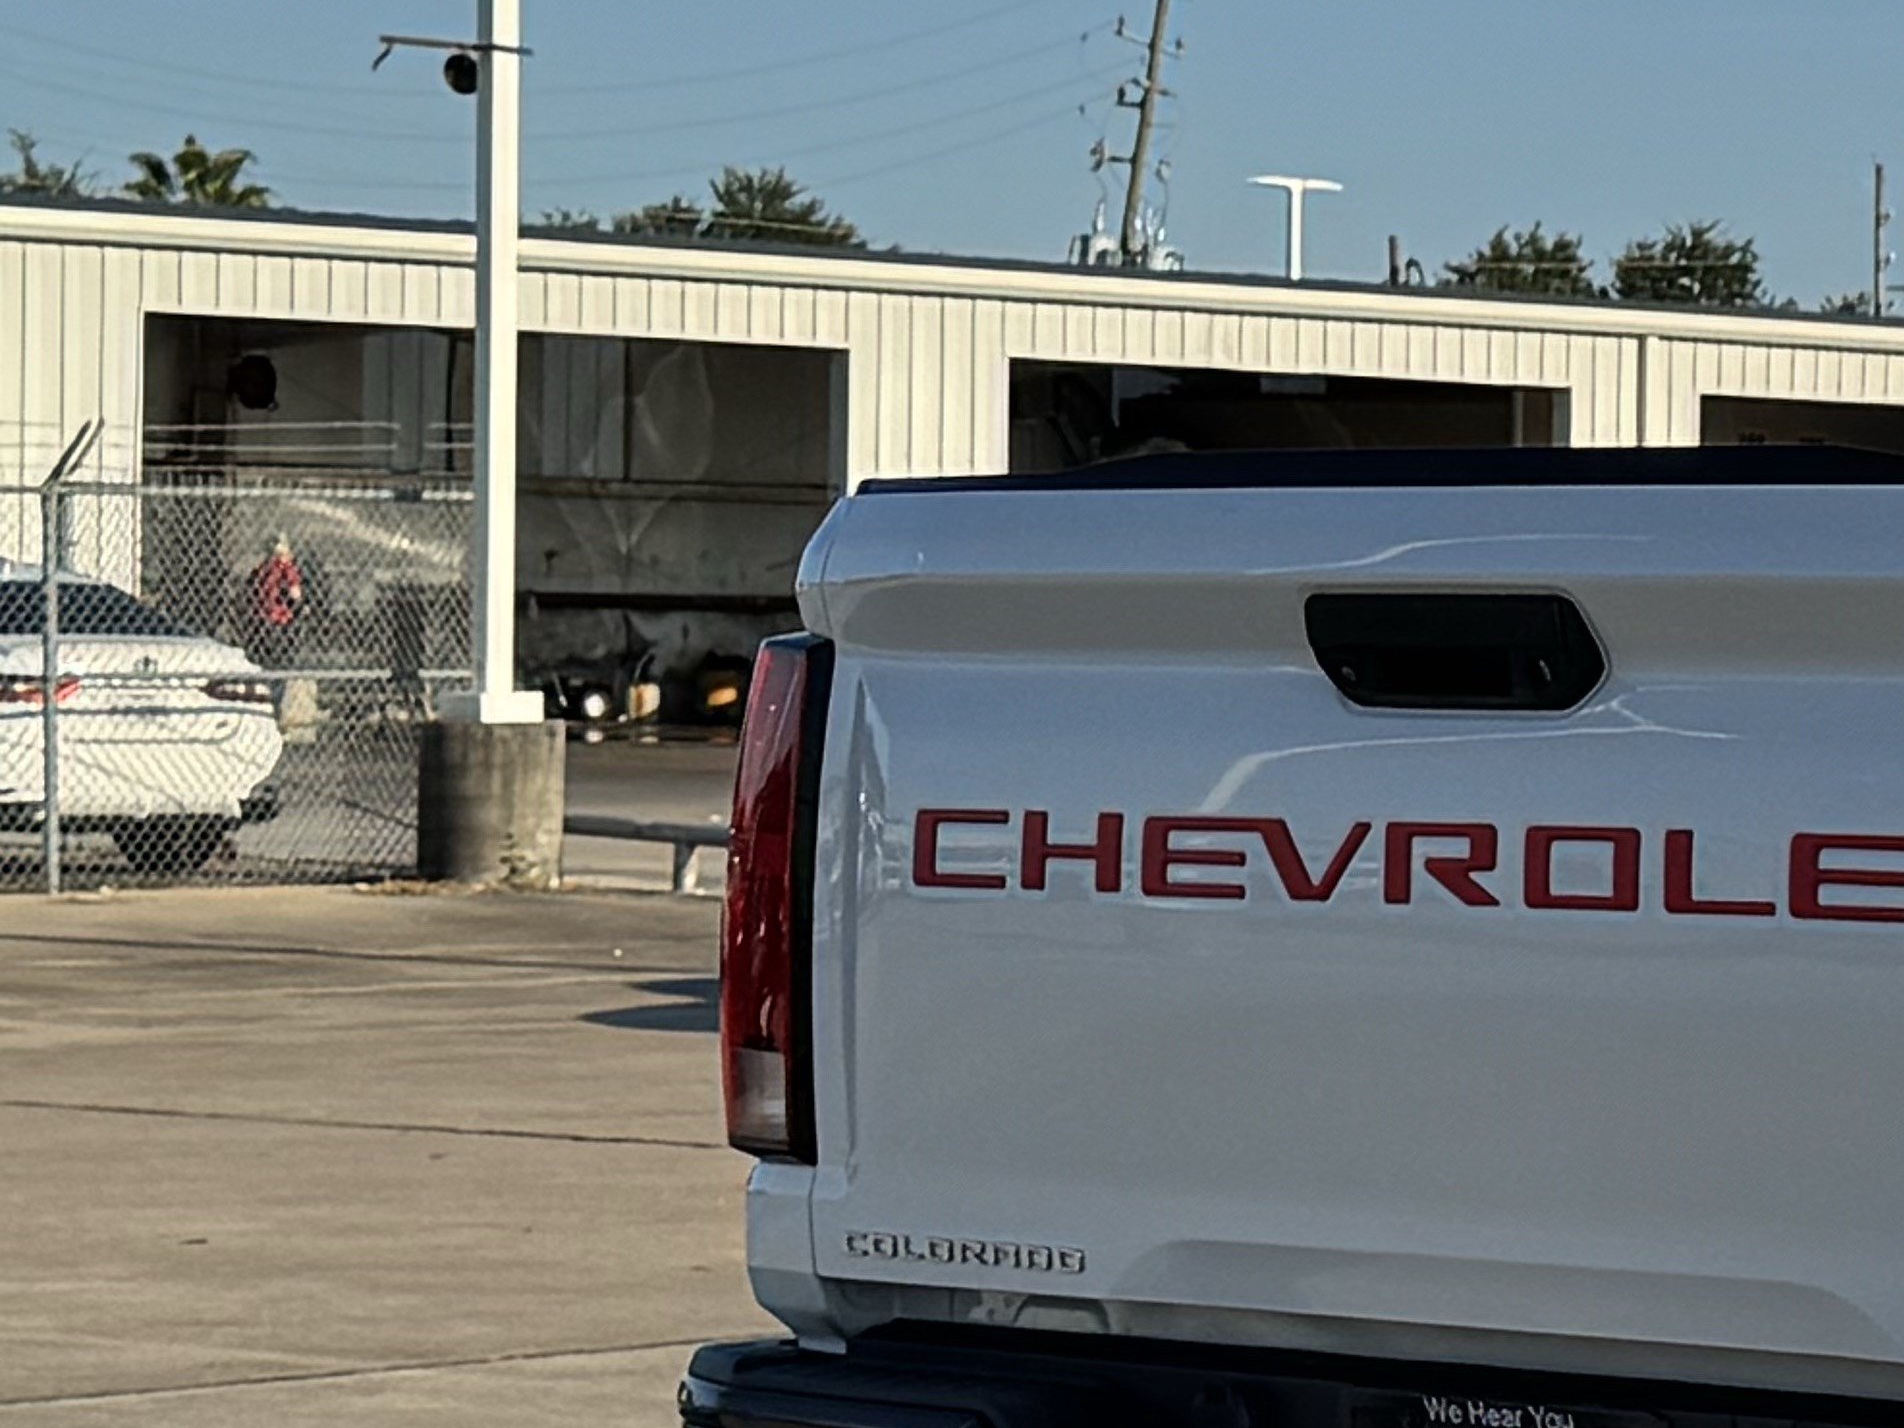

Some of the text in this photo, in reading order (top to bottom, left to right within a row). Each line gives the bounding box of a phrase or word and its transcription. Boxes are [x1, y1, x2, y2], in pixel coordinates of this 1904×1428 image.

[844, 1229, 1087, 1274] COLORADO
[1423, 1396, 1463, 1424] We
[1467, 1401, 1522, 1428] Hear
